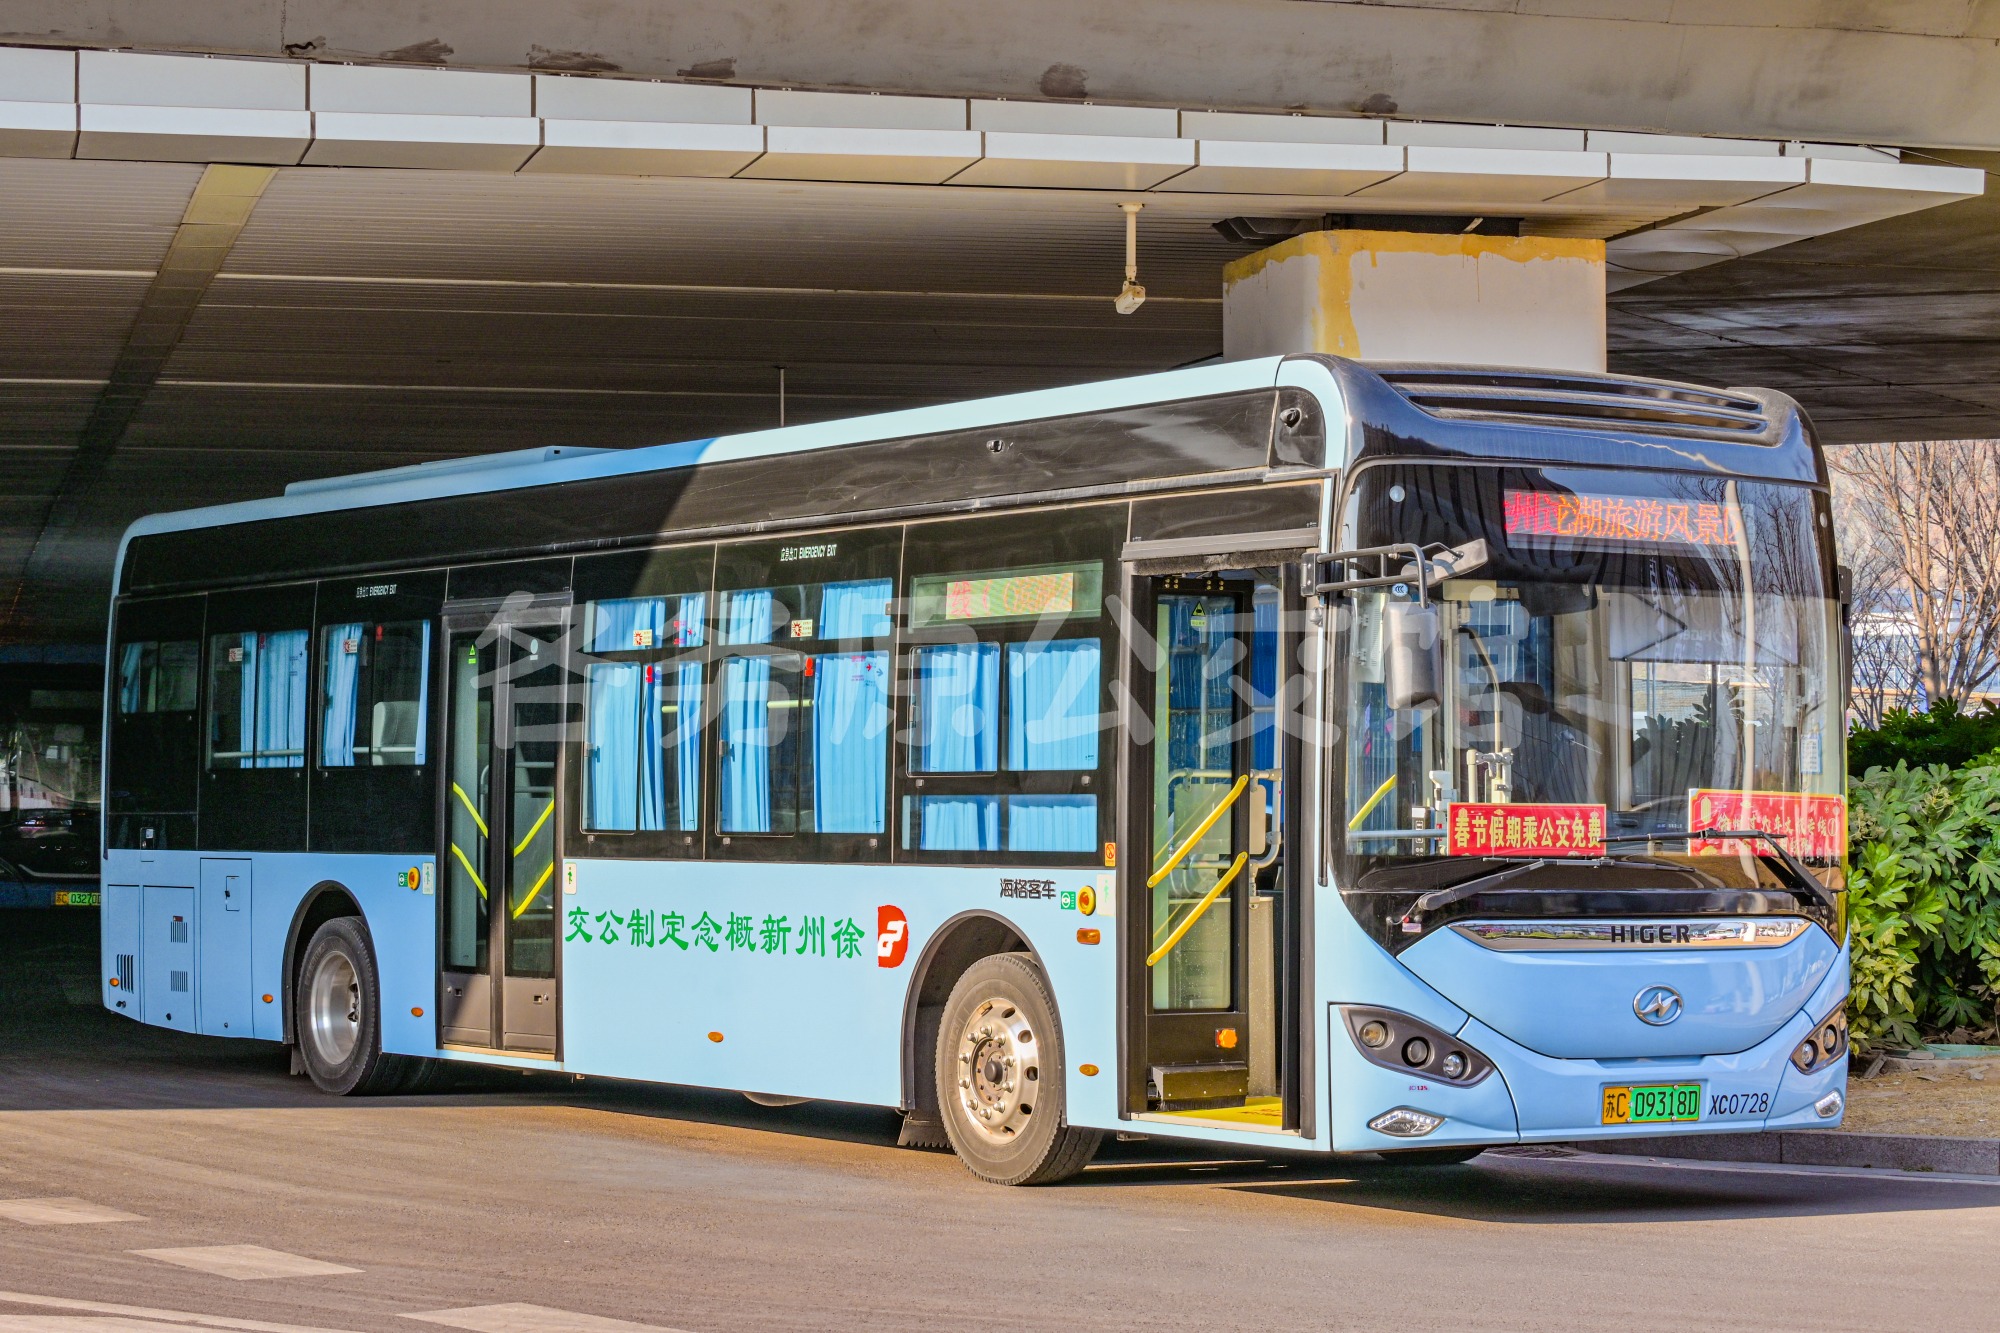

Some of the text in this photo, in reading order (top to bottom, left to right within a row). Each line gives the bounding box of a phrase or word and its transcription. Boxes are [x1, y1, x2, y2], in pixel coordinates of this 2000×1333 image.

[1454, 815, 1602, 848] 春节假期乘公交免费
[1000, 878, 1056, 899] 海格客车
[1611, 925, 1690, 943] HIGER
[1709, 1092, 1769, 1116] XC0728
